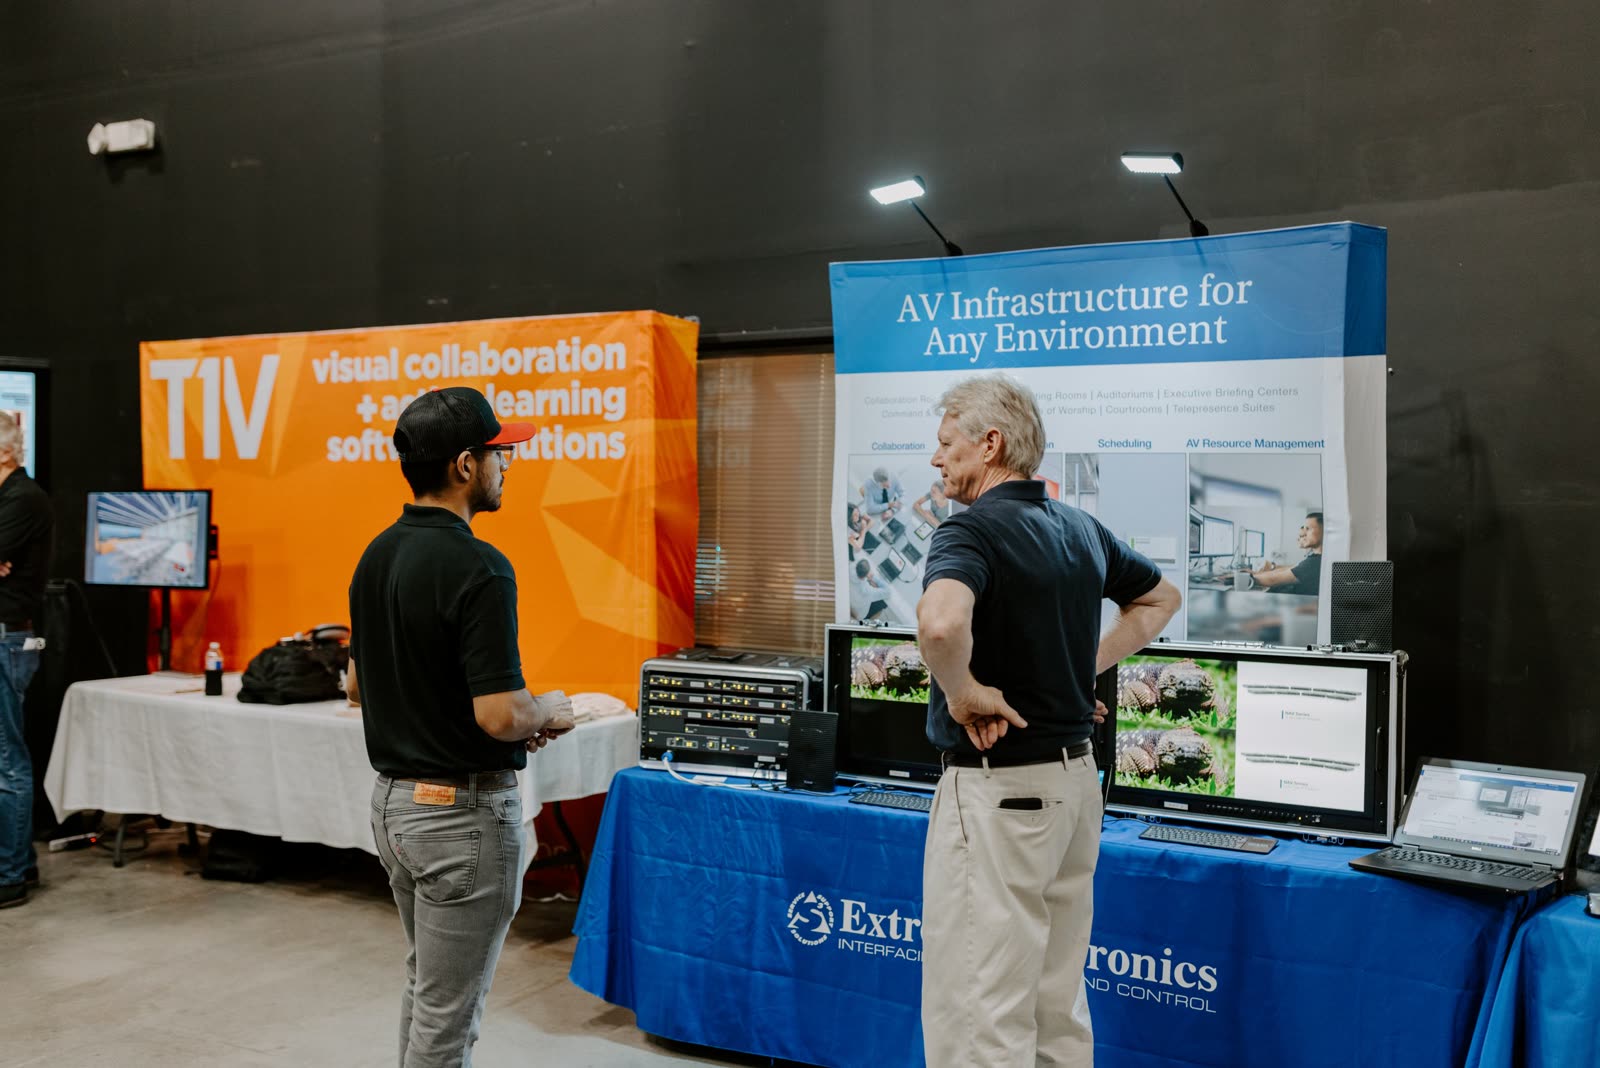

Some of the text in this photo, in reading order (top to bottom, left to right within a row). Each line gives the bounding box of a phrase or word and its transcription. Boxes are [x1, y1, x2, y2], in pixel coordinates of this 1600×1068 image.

[896, 272, 1253, 322] AV Infrastructure for
[312, 336, 626, 384] visual collaboration
[923, 315, 1228, 363] Any Environment
[150, 353, 281, 460] T1V
[486, 379, 627, 421] learning
[1055, 390, 1088, 401] Rooms
[1096, 389, 1155, 400] Auditoriums
[1163, 387, 1212, 399] Executive
[1215, 386, 1254, 399] Briefing
[1257, 386, 1299, 397] Centers
[1059, 405, 1097, 417] Worship
[1105, 404, 1163, 415] Courtrooms
[1173, 403, 1239, 415] Telepresence
[1242, 402, 1275, 413] Suites
[513, 423, 626, 461] utions
[871, 441, 926, 451] Collaboration
[1097, 438, 1153, 450] Scheduling
[1186, 438, 1326, 451] AV Resource Management
[839, 899, 1218, 993] Extr ronics
[838, 938, 1217, 1013] INTERFACI ND CONTROL
